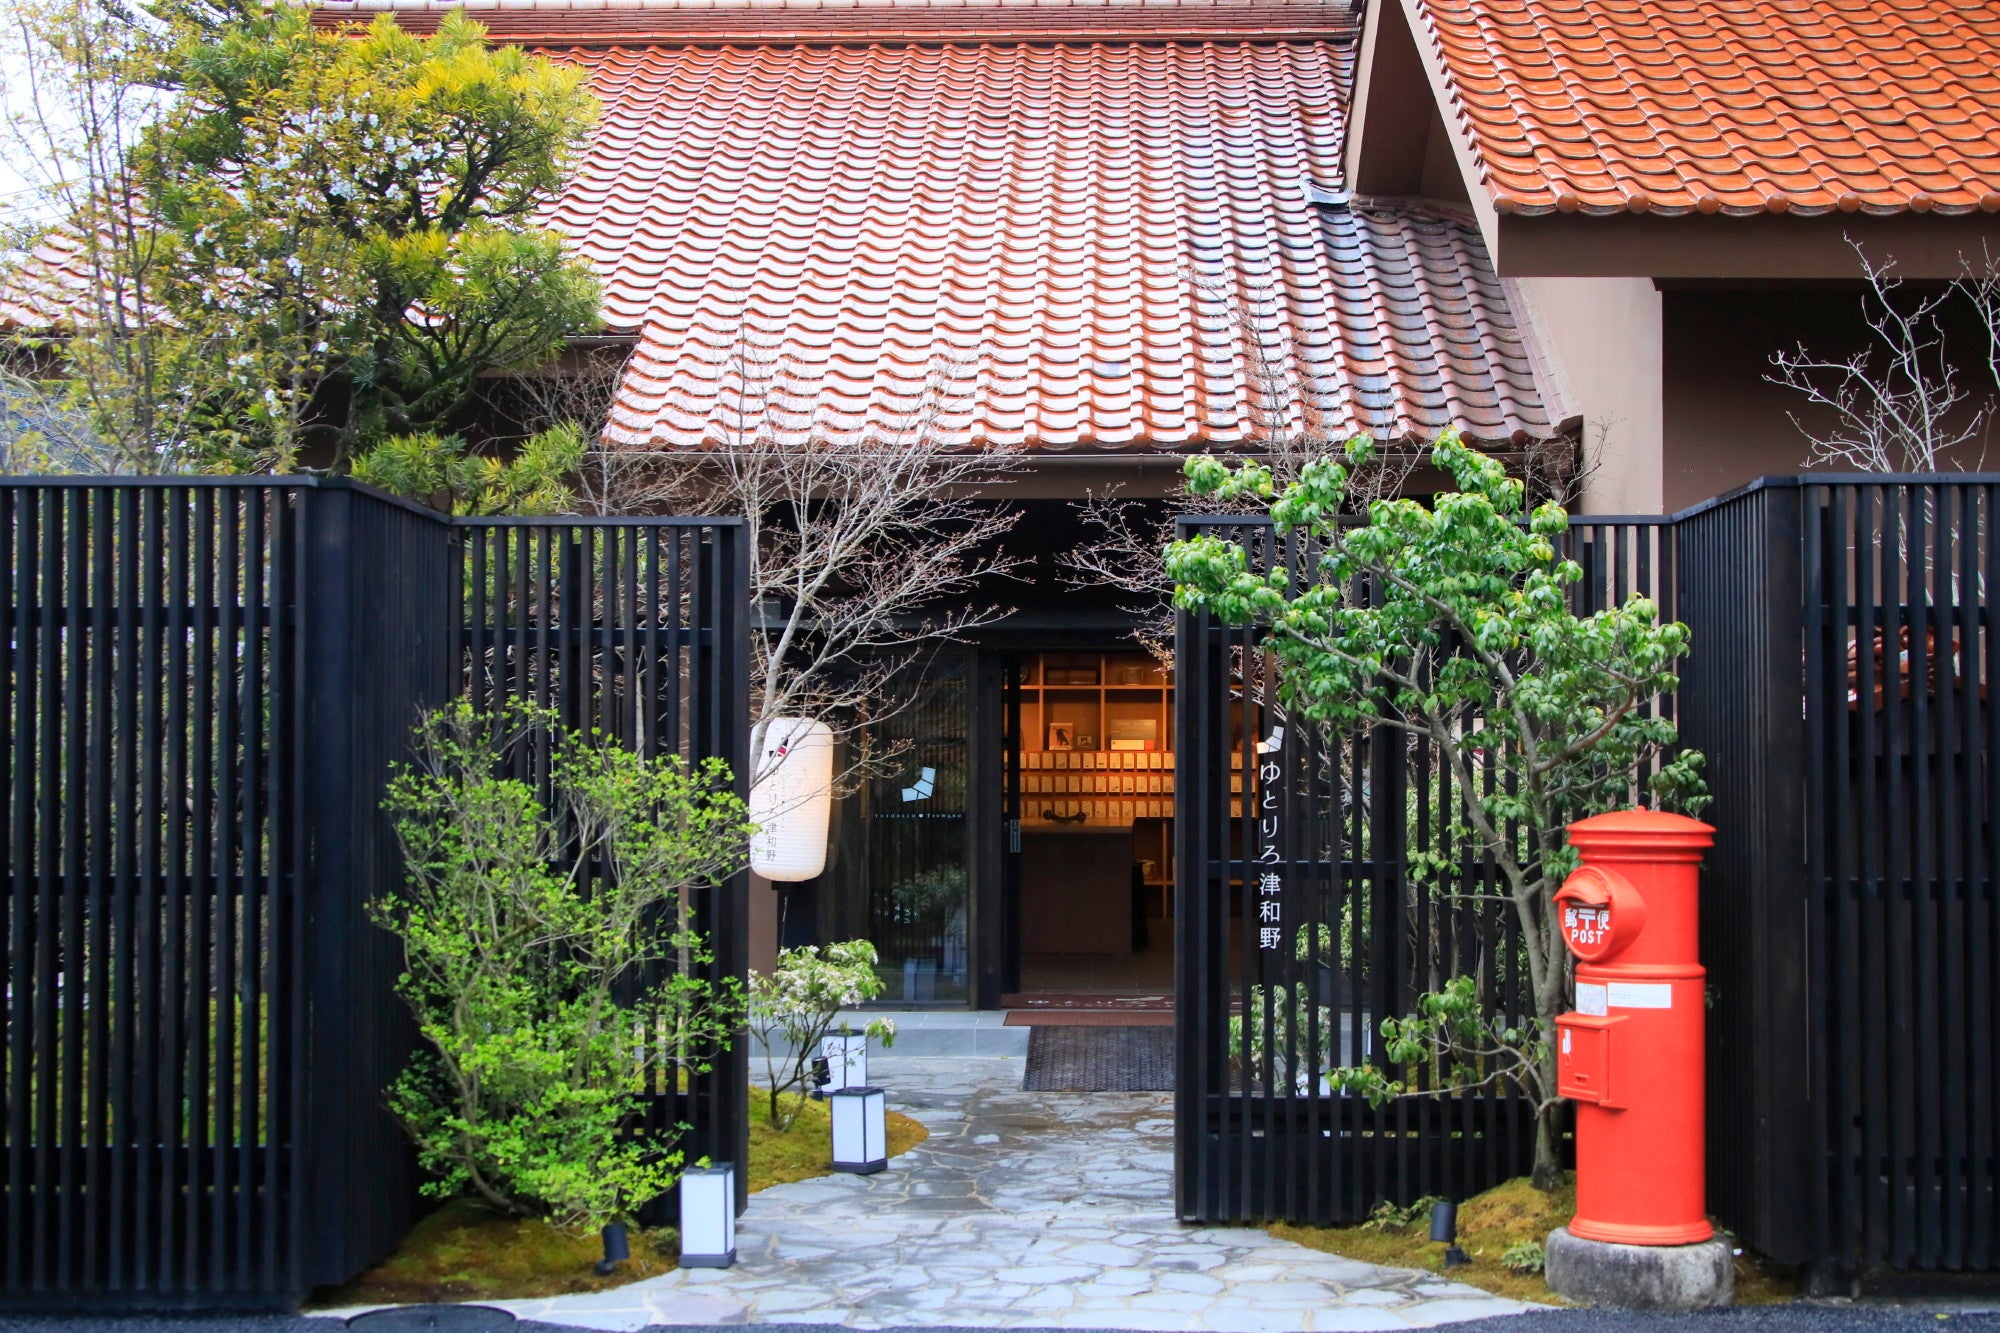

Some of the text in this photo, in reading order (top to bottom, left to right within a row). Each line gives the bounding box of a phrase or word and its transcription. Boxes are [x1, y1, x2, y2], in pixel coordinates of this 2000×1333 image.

[1259, 760, 1281, 950] ゆとりろ津和野
[1571, 929, 1604, 944] POST
